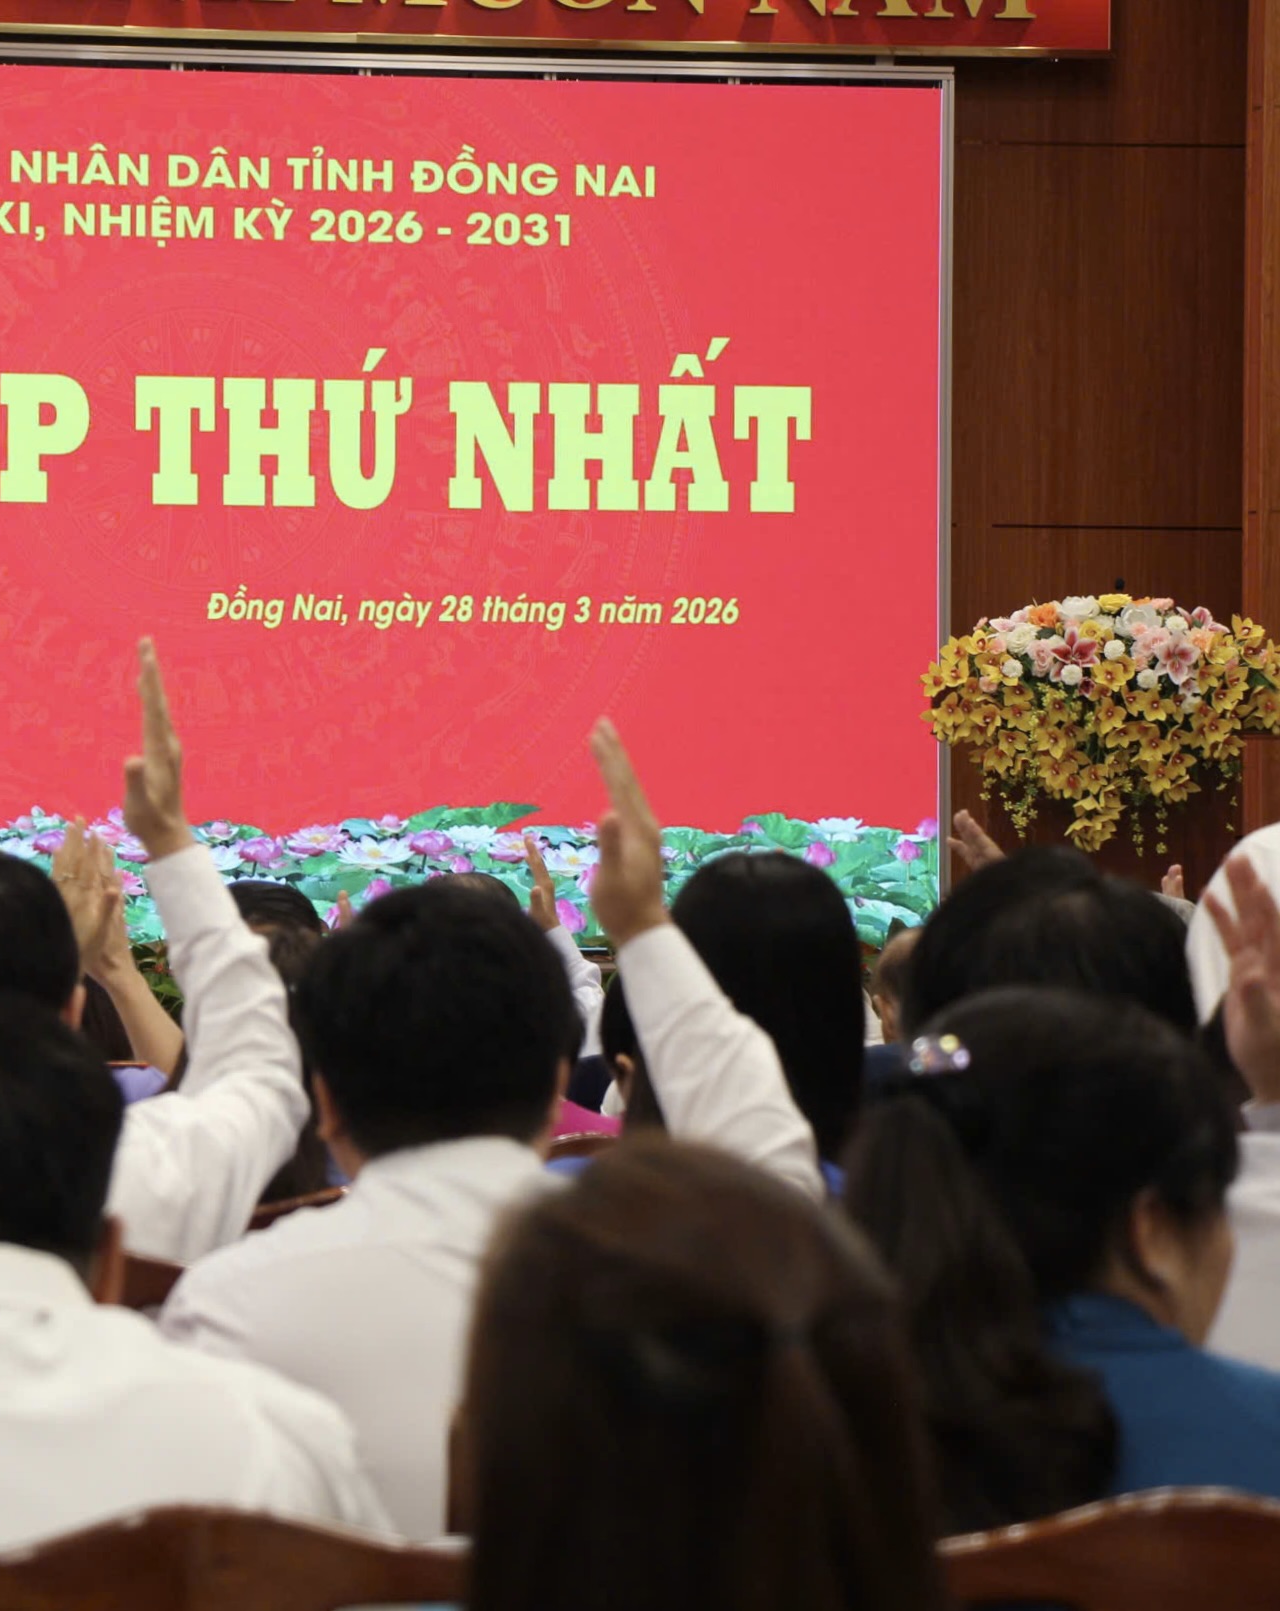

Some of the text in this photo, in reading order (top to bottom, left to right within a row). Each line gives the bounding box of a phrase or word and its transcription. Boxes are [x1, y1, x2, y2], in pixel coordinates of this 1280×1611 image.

[10, 142, 150, 187] NHÂN
[167, 145, 270, 190] DÂN
[286, 145, 394, 193] TỈNH
[409, 143, 559, 197] ĐỒNG
[575, 163, 656, 198] NAI
[63, 195, 214, 248] NHIỆM
[233, 197, 294, 241] KỲ
[310, 208, 424, 244] 2026
[466, 211, 571, 247] 2031
[134, 347, 413, 510] THỨ
[448, 336, 812, 513] NHẤT
[207, 584, 740, 632] Đồng Nai, ngày 28 tháng 3 năm 2026
